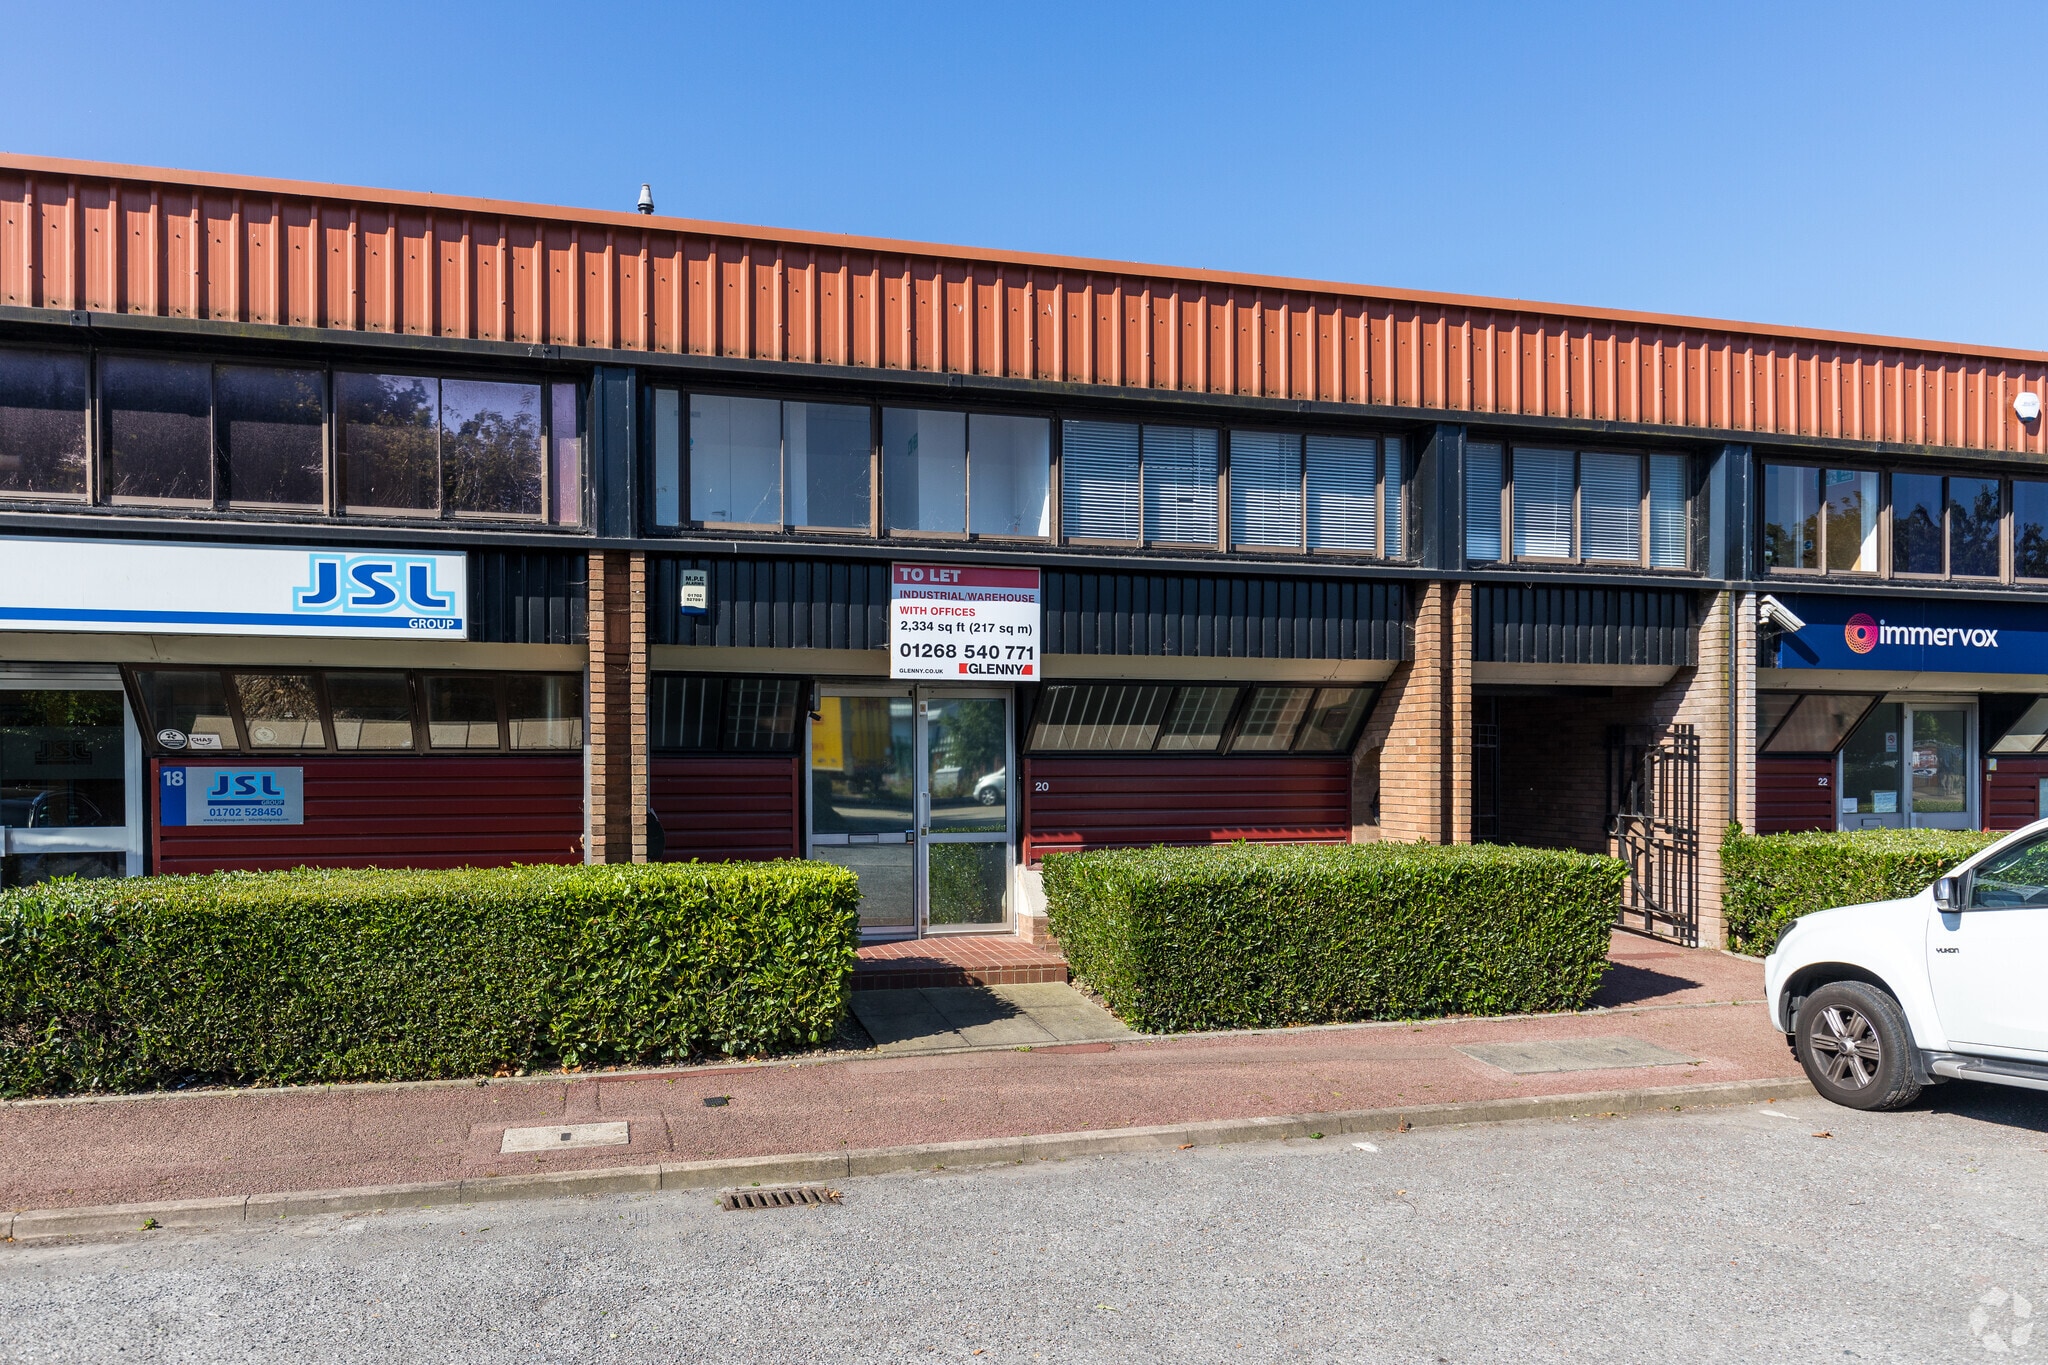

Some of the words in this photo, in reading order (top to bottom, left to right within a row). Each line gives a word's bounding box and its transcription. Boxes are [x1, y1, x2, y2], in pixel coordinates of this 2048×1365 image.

[900, 567, 924, 582] TO
[929, 568, 961, 583] LET
[297, 558, 450, 611] JSL
[899, 590, 1035, 603] INDUSTRIAL/WAREHOUSE
[900, 606, 927, 615] WITH
[930, 607, 976, 617] OFFICES
[408, 618, 455, 630] GROUP
[900, 620, 934, 632] 2,334
[938, 623, 953, 634] sq
[956, 622, 965, 632] ft
[969, 622, 995, 635] (217
[999, 625, 1014, 636] sq
[1017, 624, 1033, 636] m)
[1879, 619, 1998, 647] immervox
[900, 643, 957, 658] 01268
[964, 645, 1000, 659] 540
[1005, 646, 1034, 660] 771
[968, 663, 1023, 675] GLENNY
[163, 771, 184, 786] 18
[1817, 777, 1828, 786] 22
[209, 774, 283, 798] JSL
[1035, 782, 1049, 791] 20
[209, 808, 241, 817] 01702
[244, 808, 283, 817] 528450
